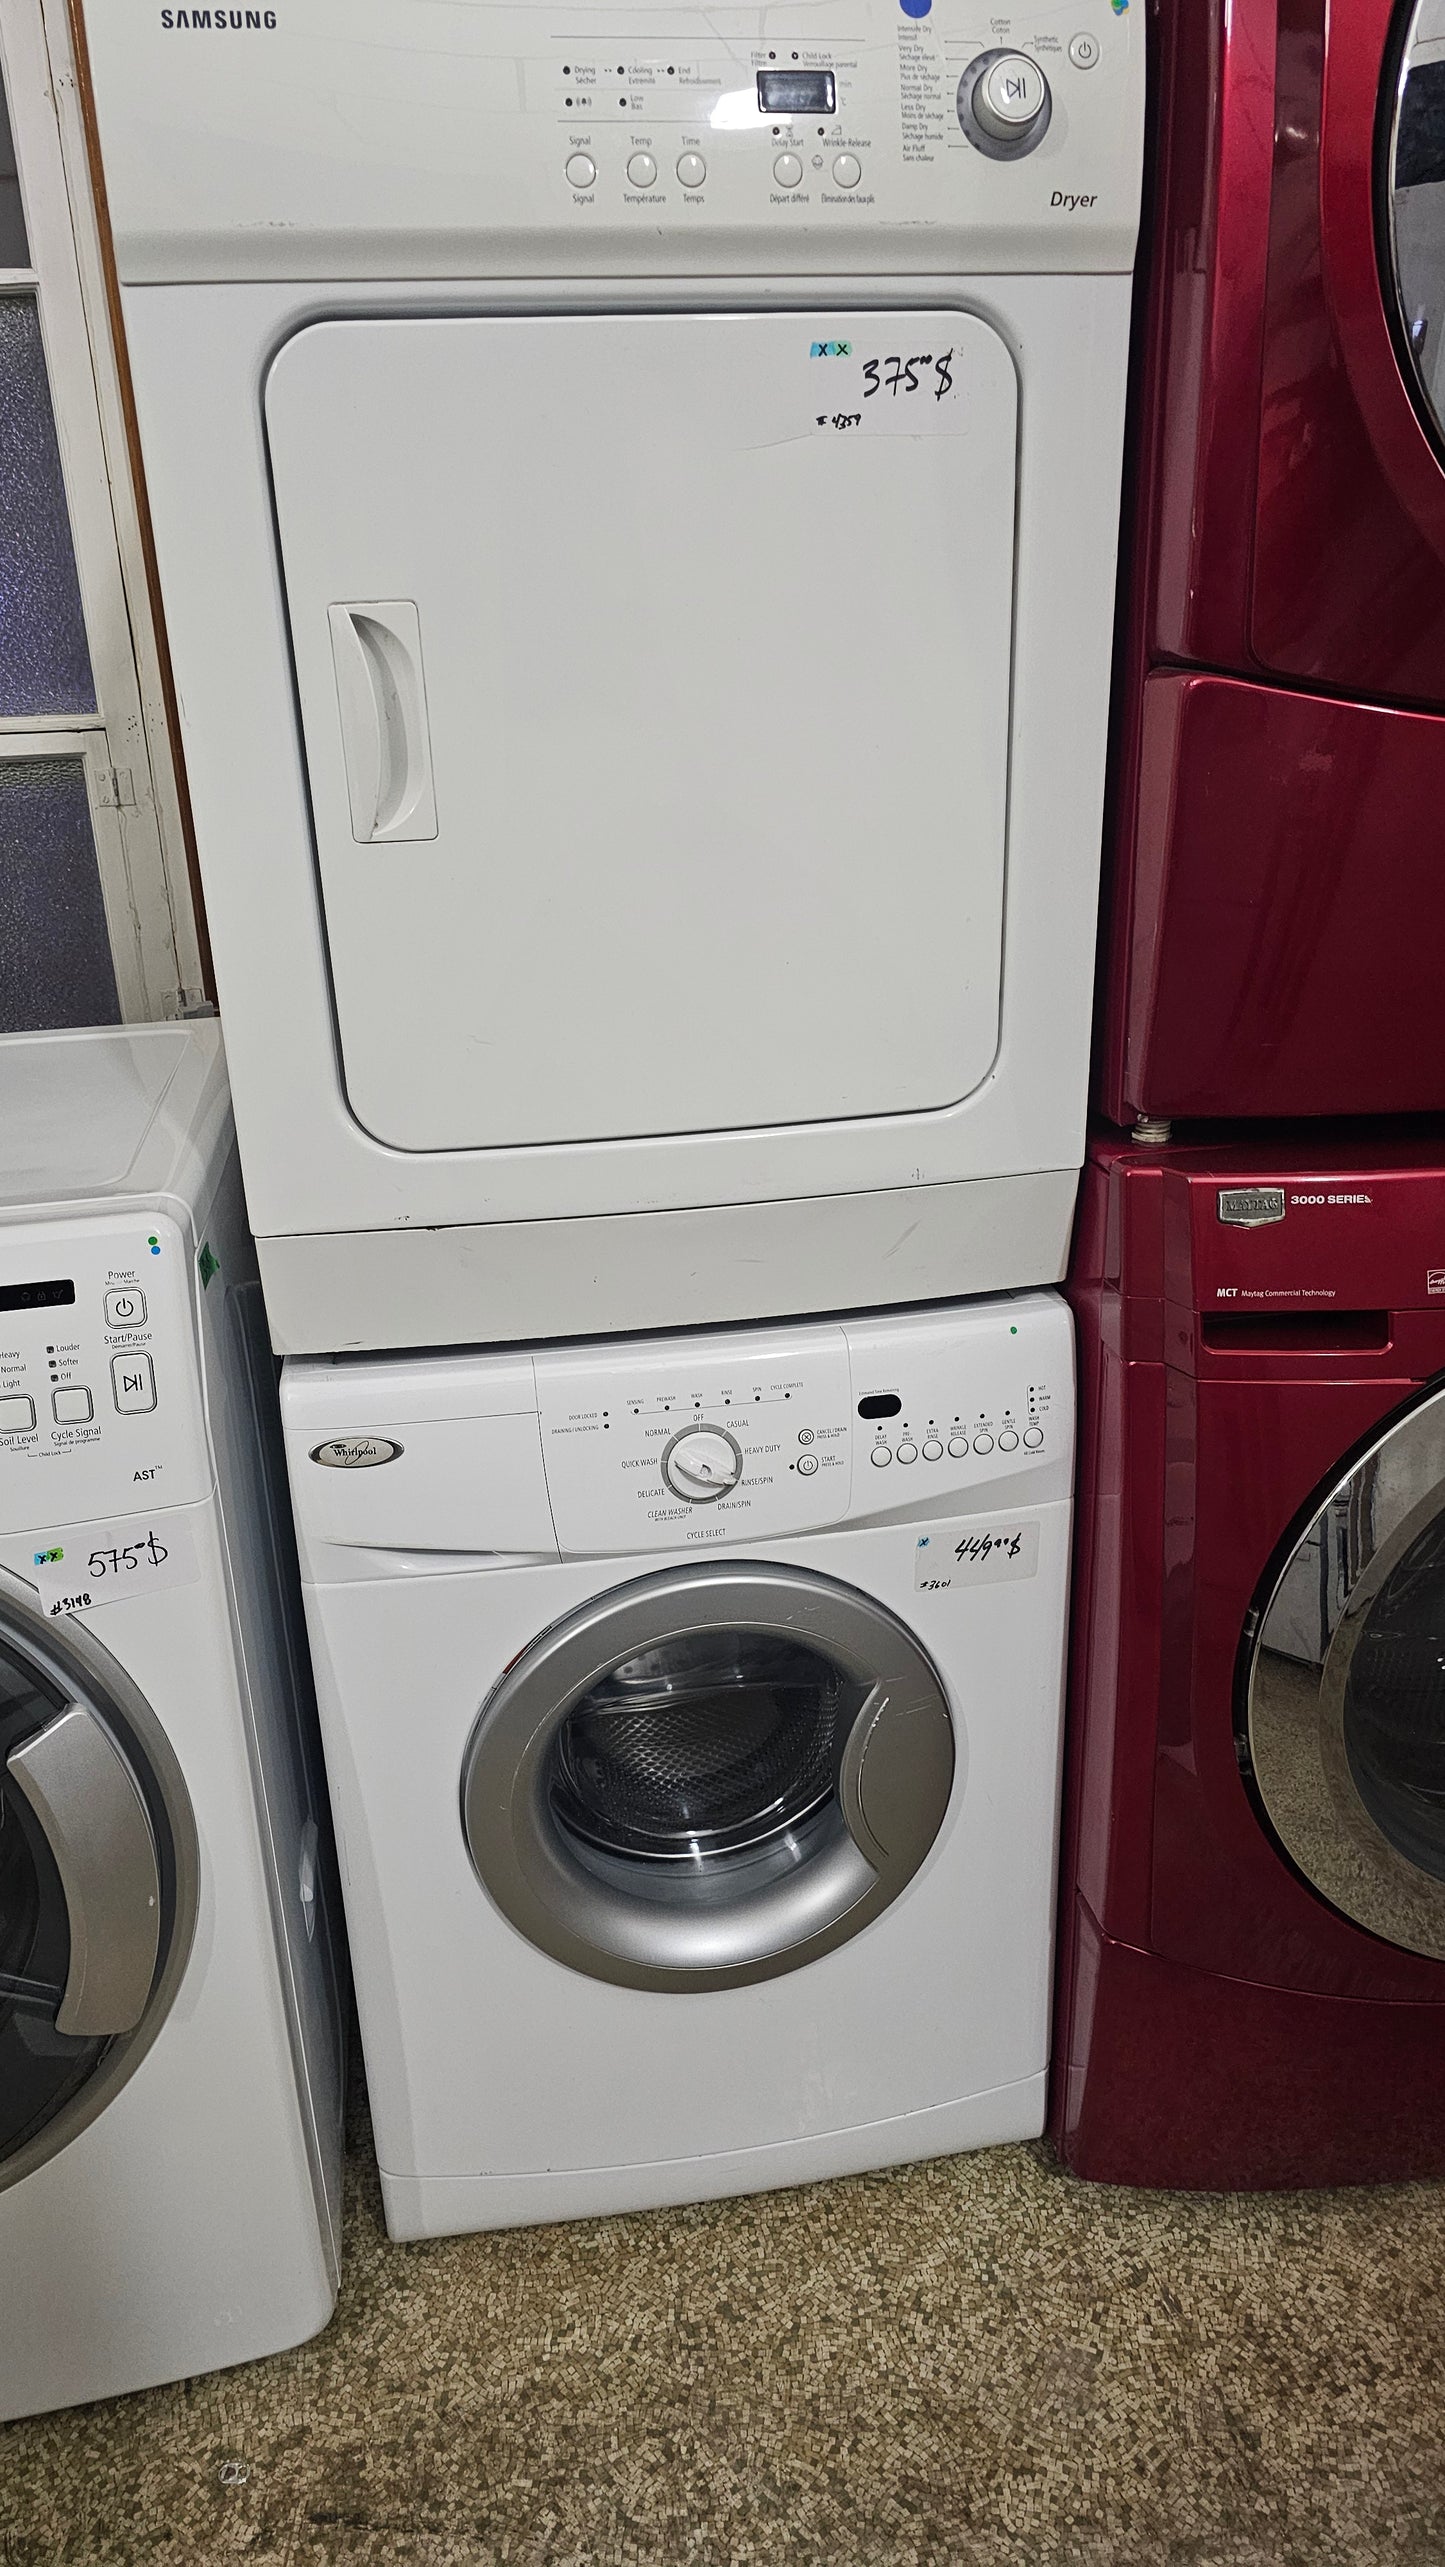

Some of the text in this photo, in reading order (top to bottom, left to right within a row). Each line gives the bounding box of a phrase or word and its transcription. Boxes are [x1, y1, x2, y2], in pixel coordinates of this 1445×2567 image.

[161, 9, 277, 29] SAMSUNG
[990, 18, 1011, 26] Cotton
[923, 25, 932, 34] Dry
[992, 26, 1010, 34] Coton
[899, 44, 924, 53] Very Dry
[574, 66, 596, 75] Drying
[628, 66, 653, 75] Cooling
[678, 66, 691, 74] End
[917, 64, 927, 73] Dry
[923, 84, 933, 93] Dry
[901, 103, 926, 112] Less Dry
[902, 122, 928, 132] Damp Dry
[569, 136, 591, 148] Signal
[631, 136, 652, 147] Temp
[682, 136, 700, 146] Time
[790, 138, 804, 147] Start
[903, 144, 926, 152] Air Fluff
[573, 194, 595, 206] Signal
[683, 194, 705, 205] Temps
[1050, 191, 1098, 211] Dryer
[1226, 1197, 1279, 1212] MAYTAG
[1291, 1195, 1325, 1205] 3000
[108, 1271, 135, 1280] Power
[1216, 1288, 1336, 1298] MCT Maytag Commercial Technology
[104, 1333, 153, 1345] Start/Pause
[56, 1343, 80, 1353] Louder
[58, 1357, 79, 1367] Softer
[0, 1363, 27, 1373] Normal
[60, 1372, 72, 1381] Off
[3, 1379, 21, 1389] Light
[770, 1383, 782, 1391] CYCLE
[626, 1398, 645, 1406] SENSING
[568, 1412, 598, 1421] DOOR LOCKED
[693, 1413, 704, 1422] OFF
[726, 1419, 750, 1428] CASUAL
[50, 1426, 102, 1441] Cycle Signal
[644, 1427, 671, 1437] NORMAL
[16, 1433, 39, 1445] Level
[333, 1446, 377, 1457] Whirlpool
[744, 1444, 781, 1455] HEAVY DUTY
[621, 1458, 658, 1469] QUICK WASH
[741, 1476, 773, 1486] RINSE/SPIN
[637, 1488, 665, 1498] DELICATE
[717, 1500, 751, 1511] DRAIN/SPIN
[647, 1509, 667, 1518] CLEAN
[668, 1507, 693, 1517] WASHER
[686, 1528, 726, 1539] CYCLE SELECT
